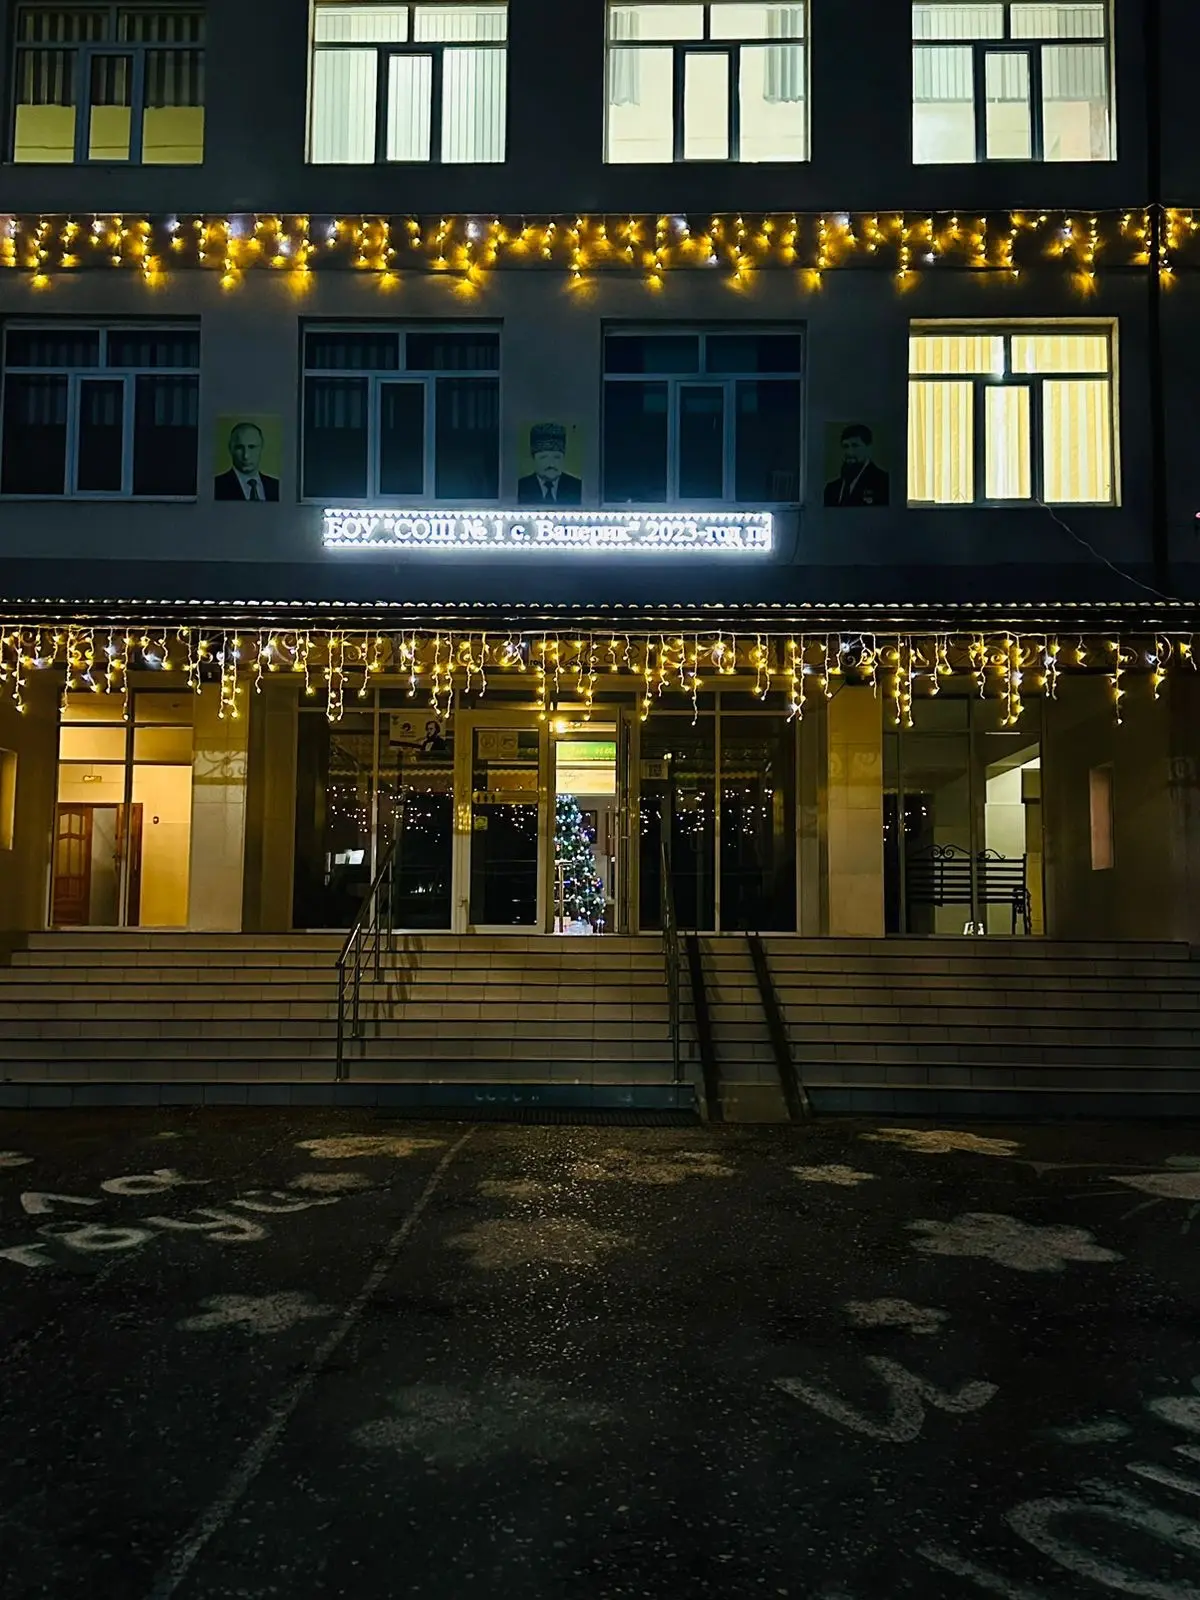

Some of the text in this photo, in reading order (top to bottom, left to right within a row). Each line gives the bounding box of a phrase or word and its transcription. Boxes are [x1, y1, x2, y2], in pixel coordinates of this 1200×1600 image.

[323, 517, 379, 539] БОУ
[460, 518, 488, 540] №
[494, 519, 505, 540] 1
